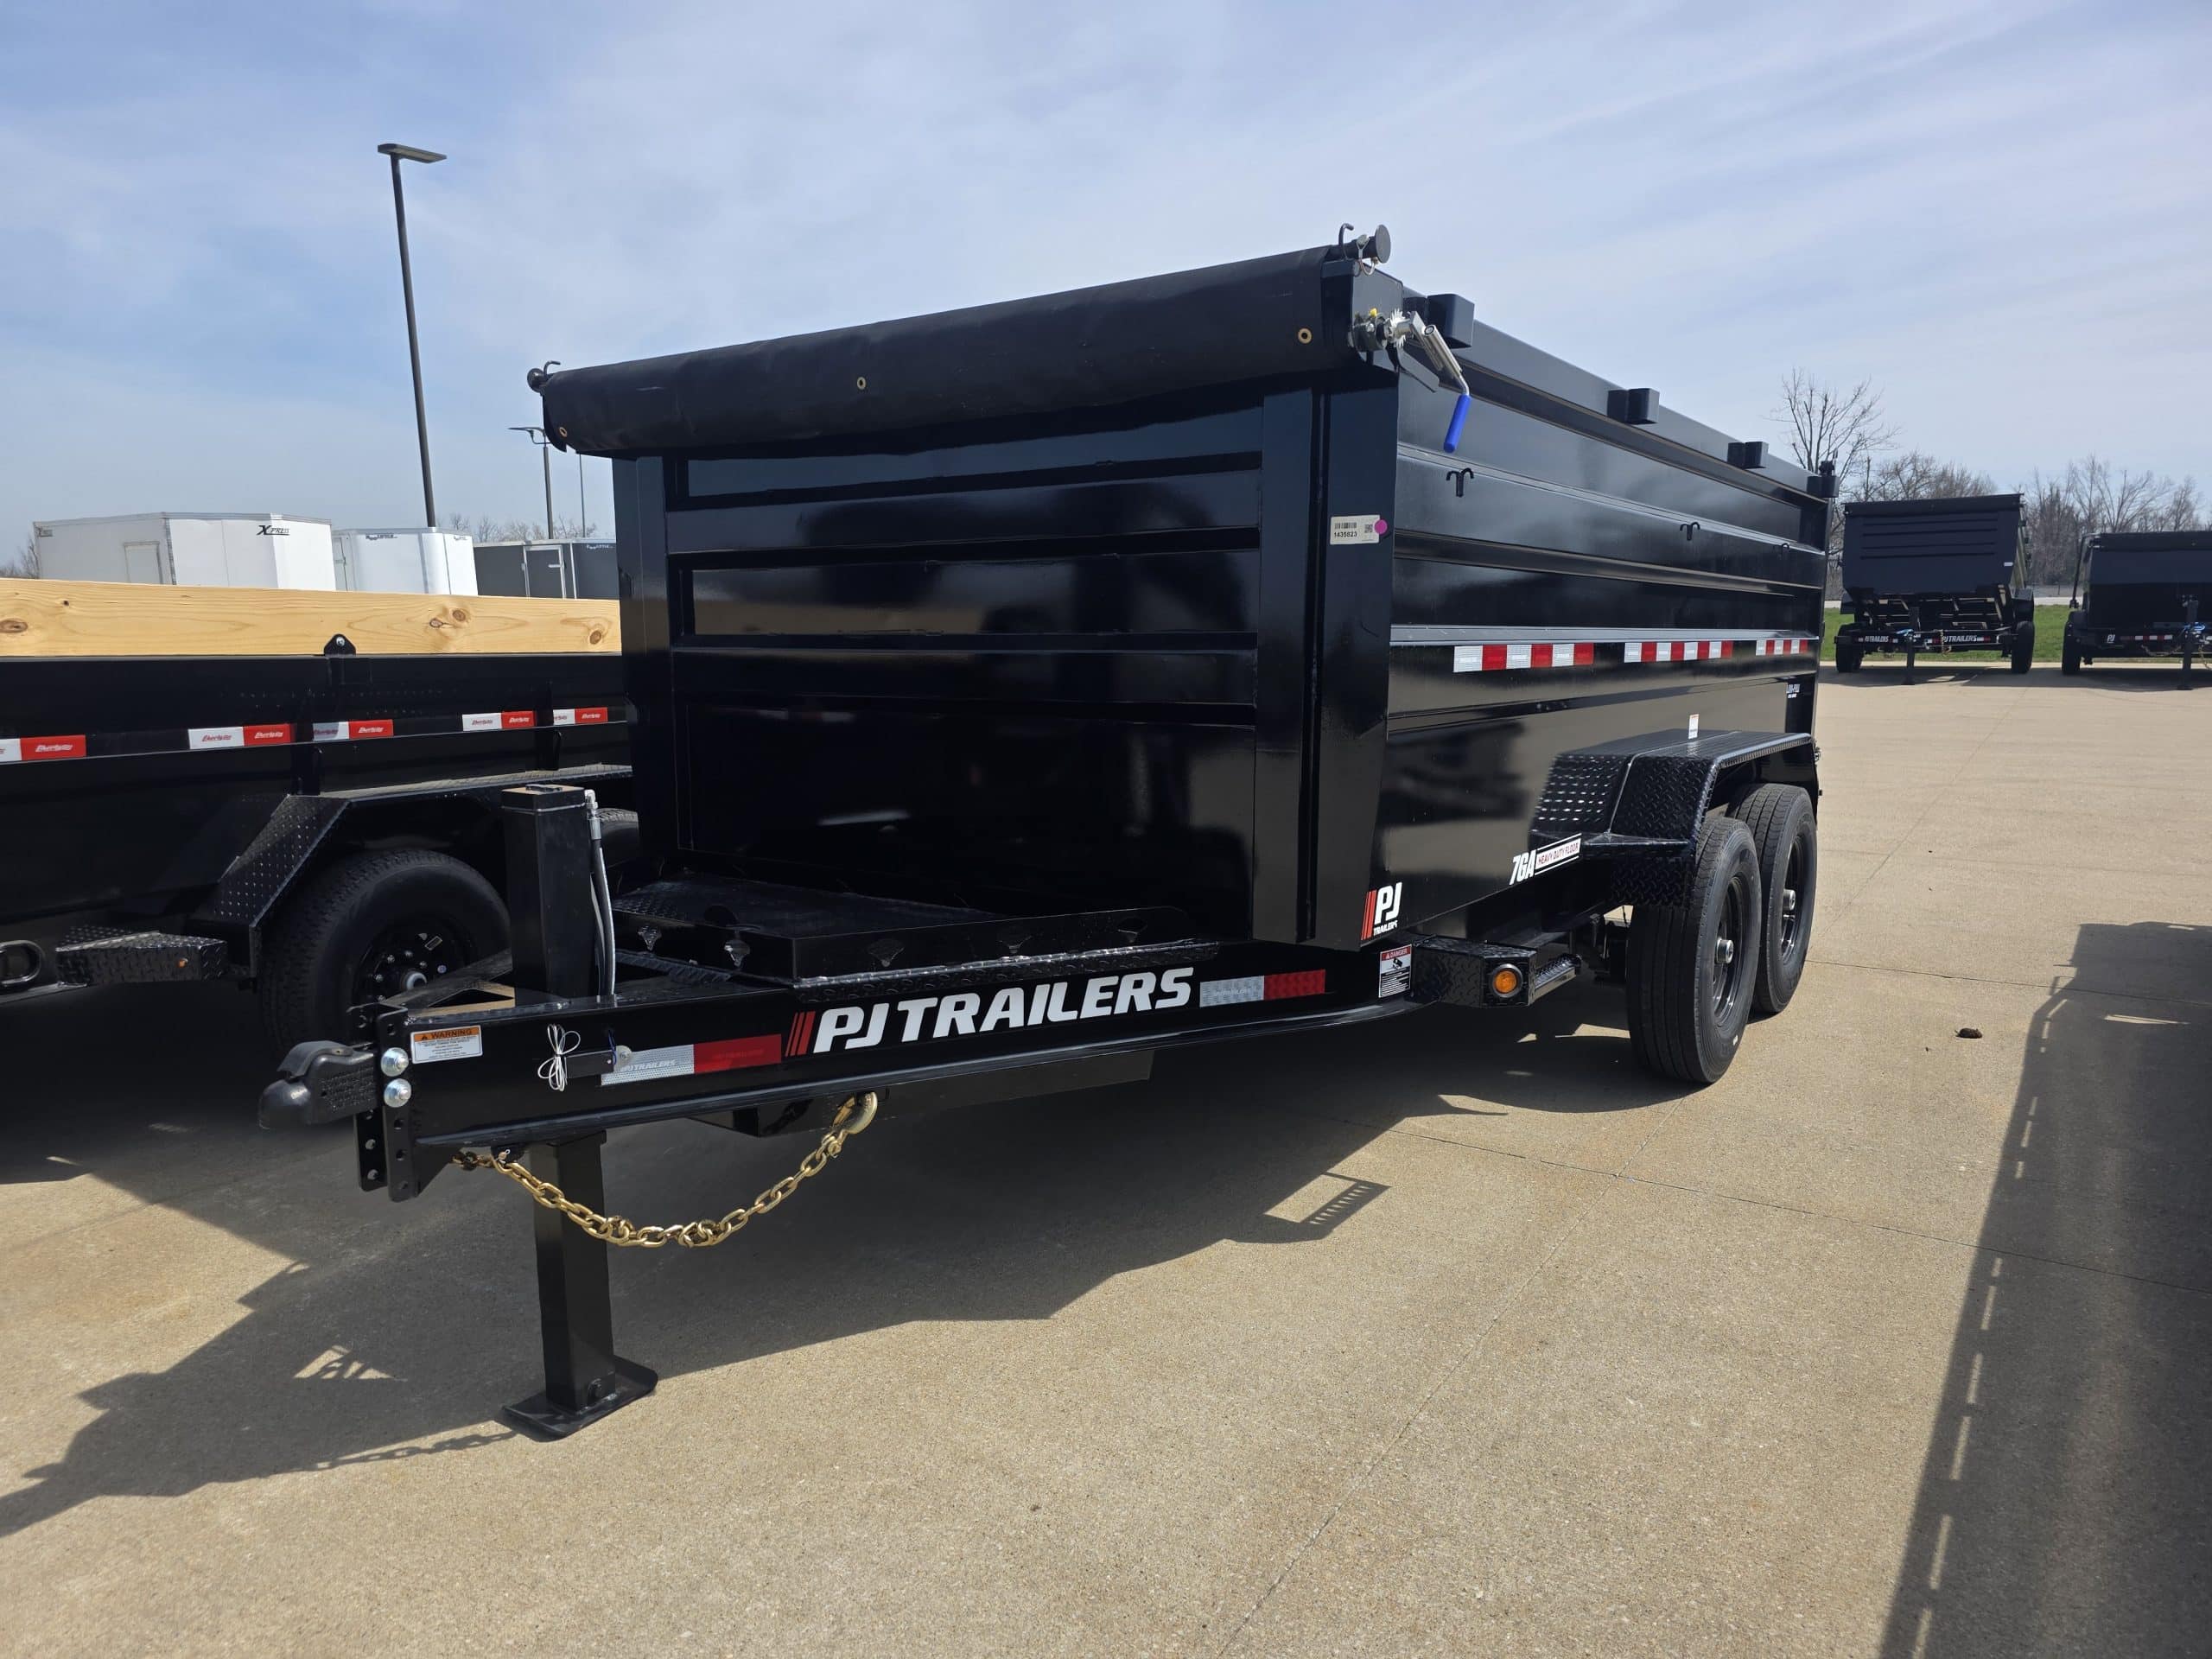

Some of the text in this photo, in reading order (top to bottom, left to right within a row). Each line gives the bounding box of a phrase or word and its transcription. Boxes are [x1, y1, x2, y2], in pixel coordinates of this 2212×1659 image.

[1374, 881, 1403, 925] PJ
[1373, 919, 1399, 937] TRAILERS
[813, 966, 1194, 1053] PJ TRAILERS
[432, 1028, 472, 1039] WARNING
